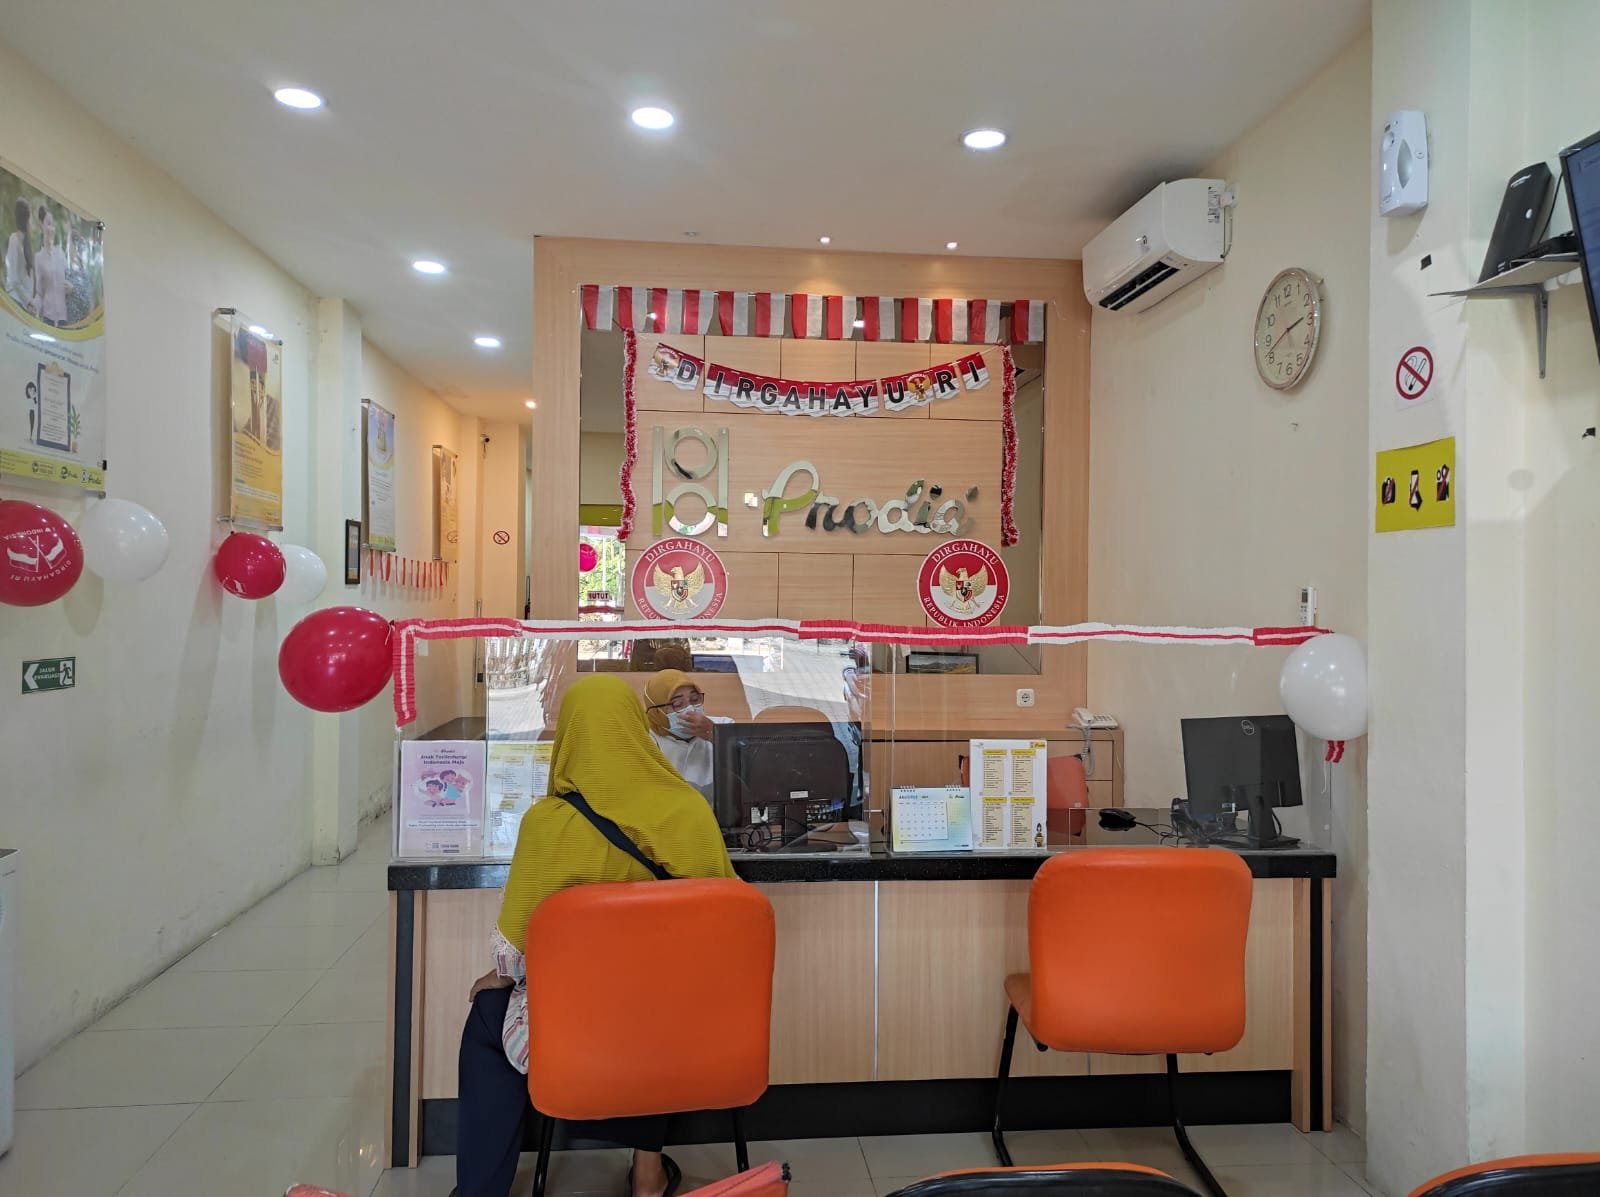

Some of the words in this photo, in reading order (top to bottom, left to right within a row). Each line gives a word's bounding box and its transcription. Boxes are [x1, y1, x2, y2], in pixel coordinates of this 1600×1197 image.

[1303, 293, 1310, 307] 2
[1306, 312, 1313, 326] 3
[1265, 335, 1272, 347] 9
[1277, 362, 1282, 374] 7
[1286, 363, 1293, 376] 6
[676, 358, 905, 410] DIRGAHAYU
[934, 360, 980, 394] RI
[761, 460, 976, 537] Prodia
[645, 541, 716, 563] DIRGAHAYU
[931, 543, 999, 565] DIRGAHAYU
[923, 597, 958, 628] REPUBLIK
[963, 594, 1005, 628] INDONESIA
